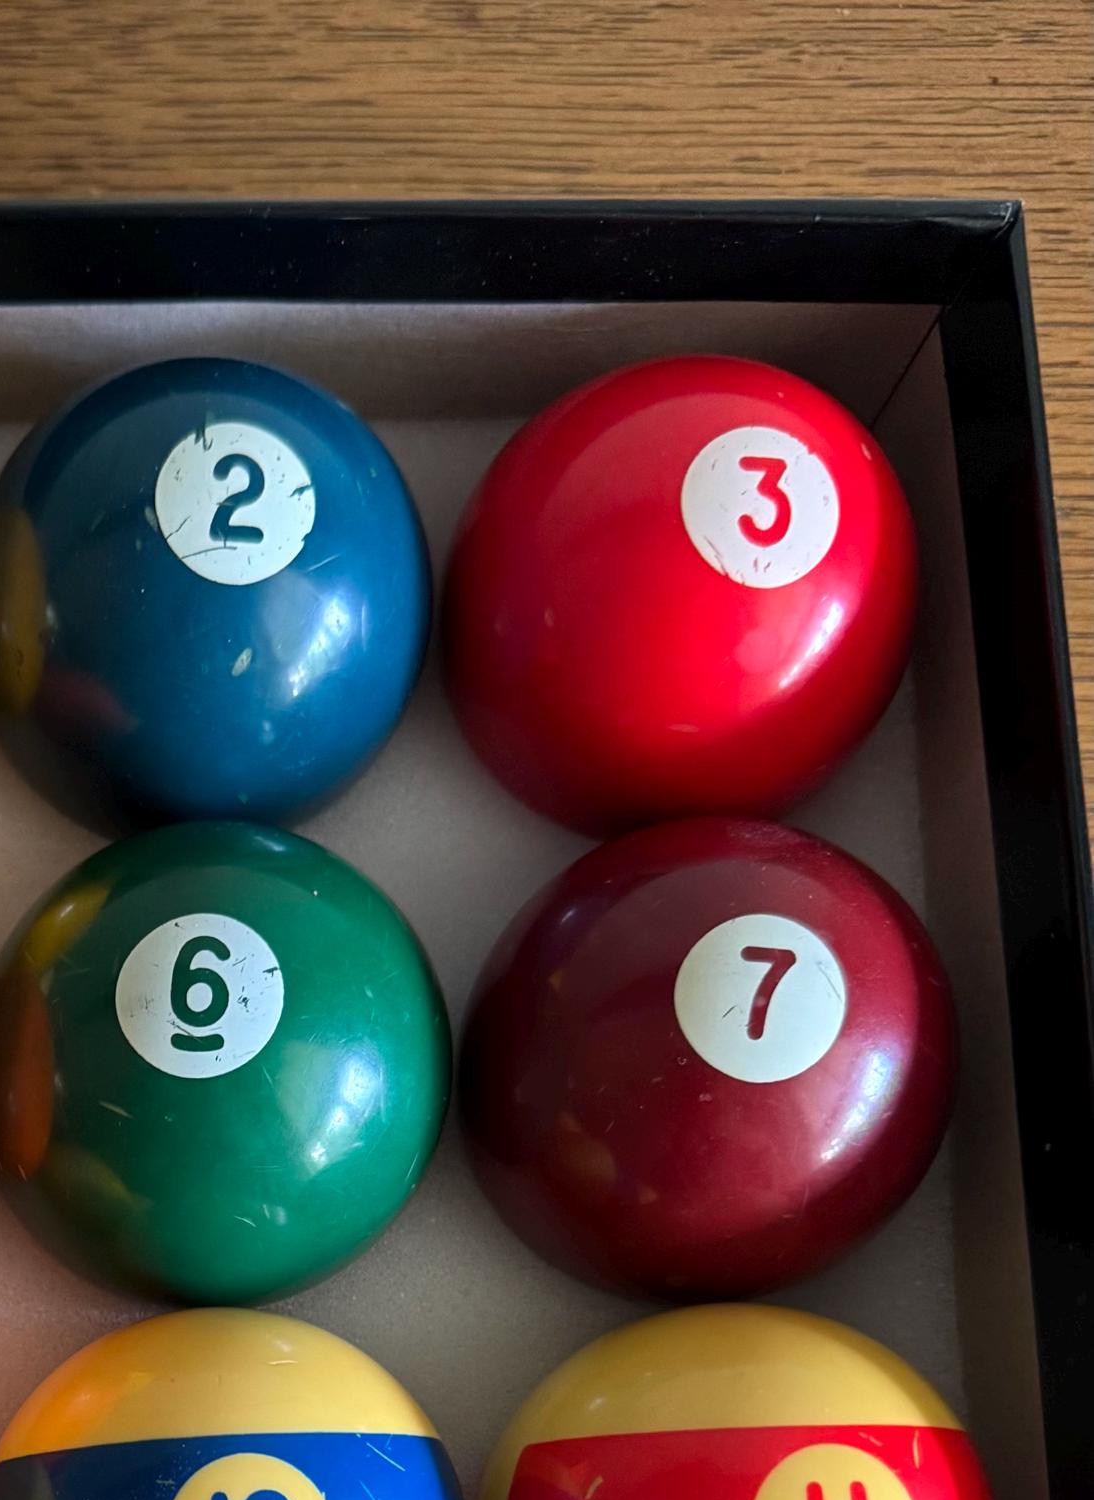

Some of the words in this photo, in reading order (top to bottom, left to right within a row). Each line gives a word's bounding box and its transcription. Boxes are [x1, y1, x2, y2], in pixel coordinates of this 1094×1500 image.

[209, 453, 265, 544] 2
[738, 456, 791, 548] 3
[171, 936, 230, 1027] 6
[741, 946, 796, 1040] 7
